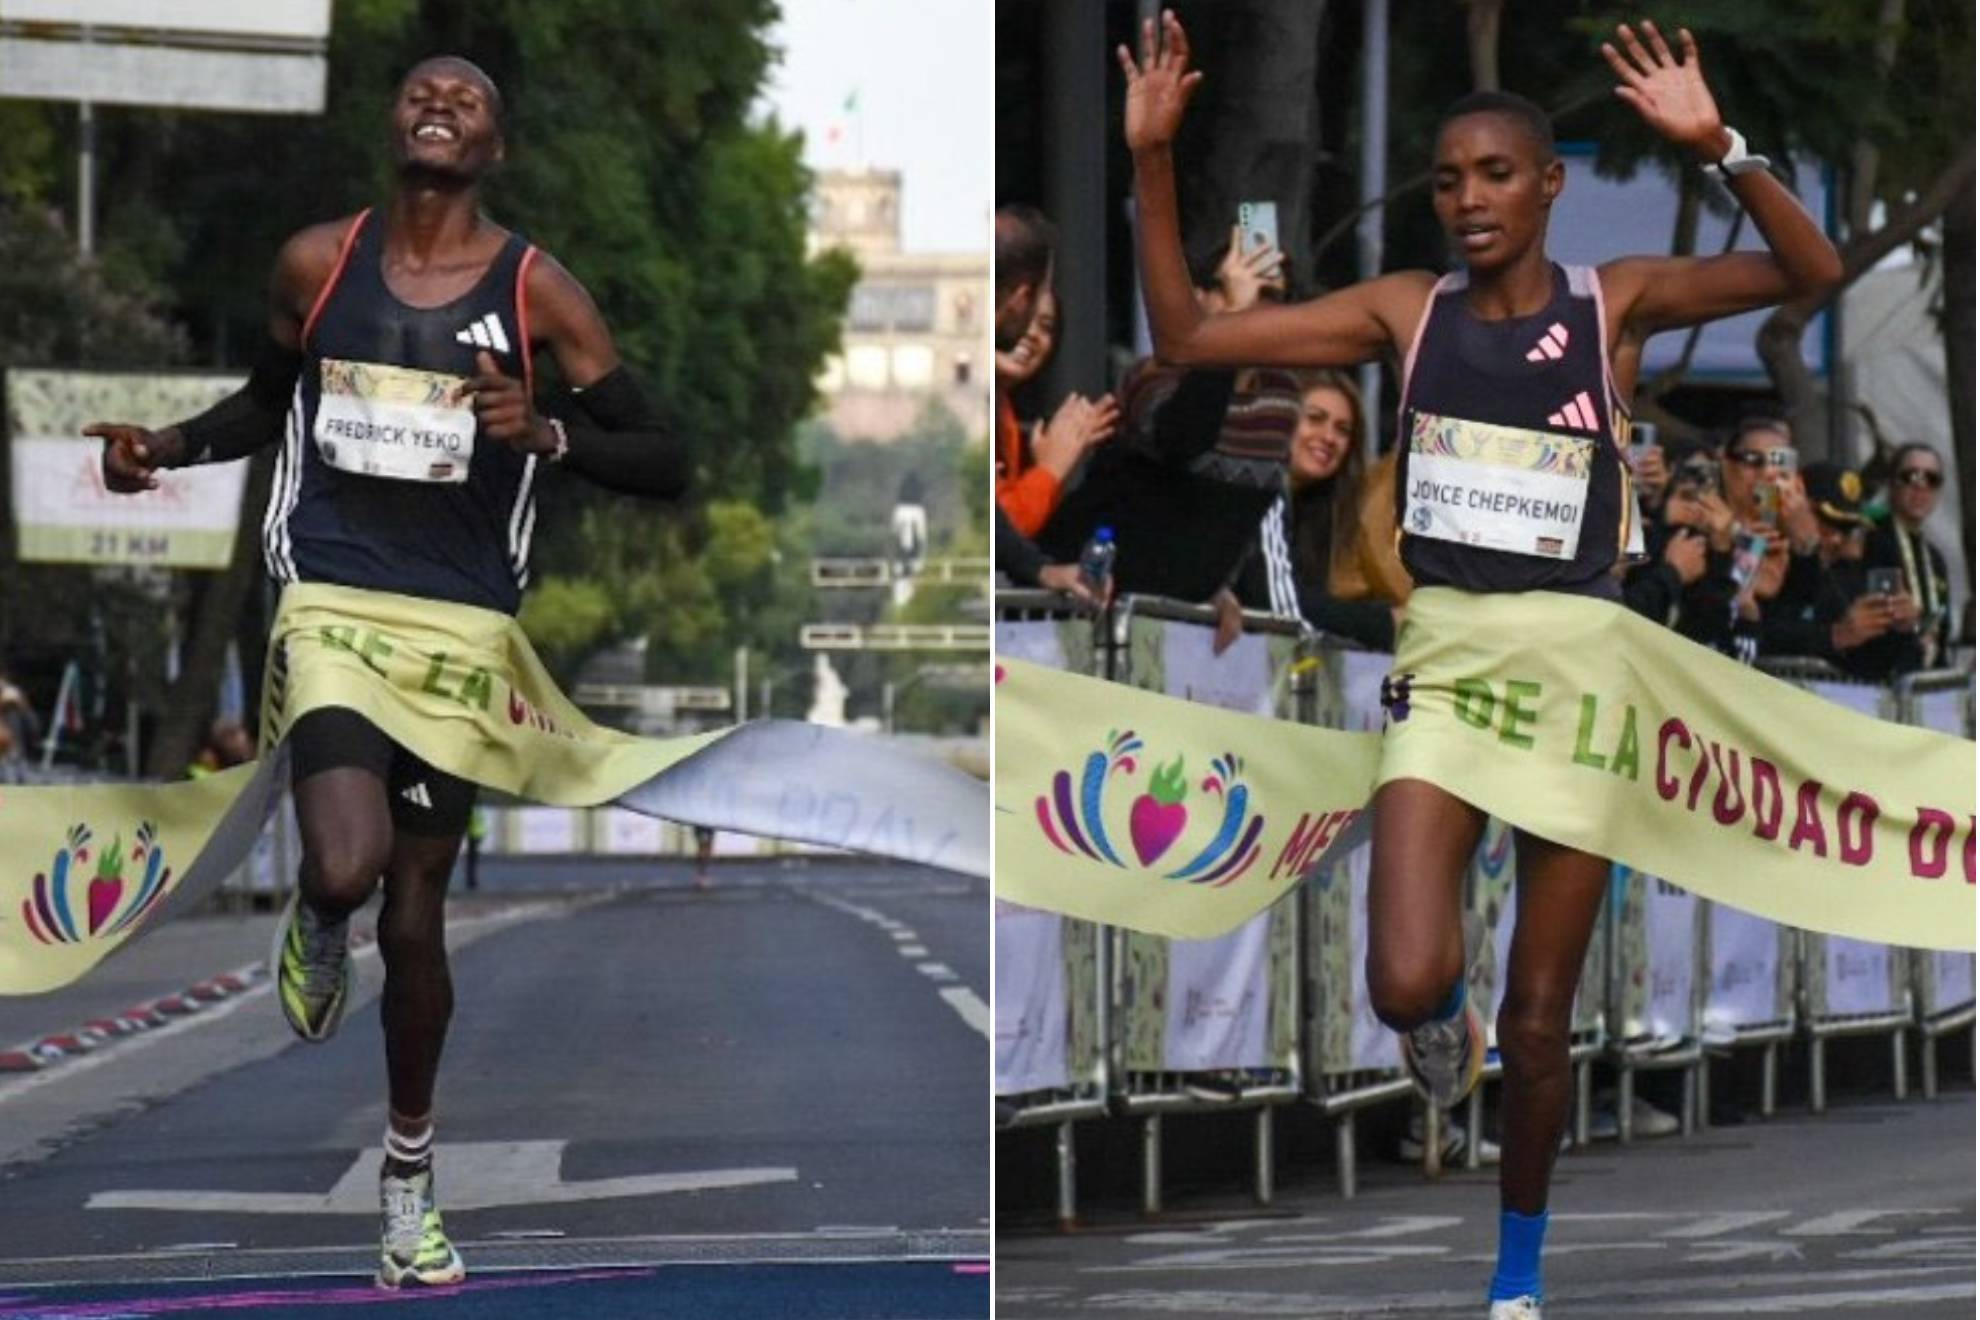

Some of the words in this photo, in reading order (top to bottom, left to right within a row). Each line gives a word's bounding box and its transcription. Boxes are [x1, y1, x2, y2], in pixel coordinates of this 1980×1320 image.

[324, 418, 407, 446] FREDRICK
[411, 430, 461, 451] YEKO
[1411, 479, 1464, 506] JOYCE
[1468, 489, 1578, 523] CHEPKEMOI
[421, 652, 493, 712] LA
[1454, 677, 1543, 750] DE
[1572, 693, 1640, 783] LA
[1656, 716, 1882, 867] CIUDAD
